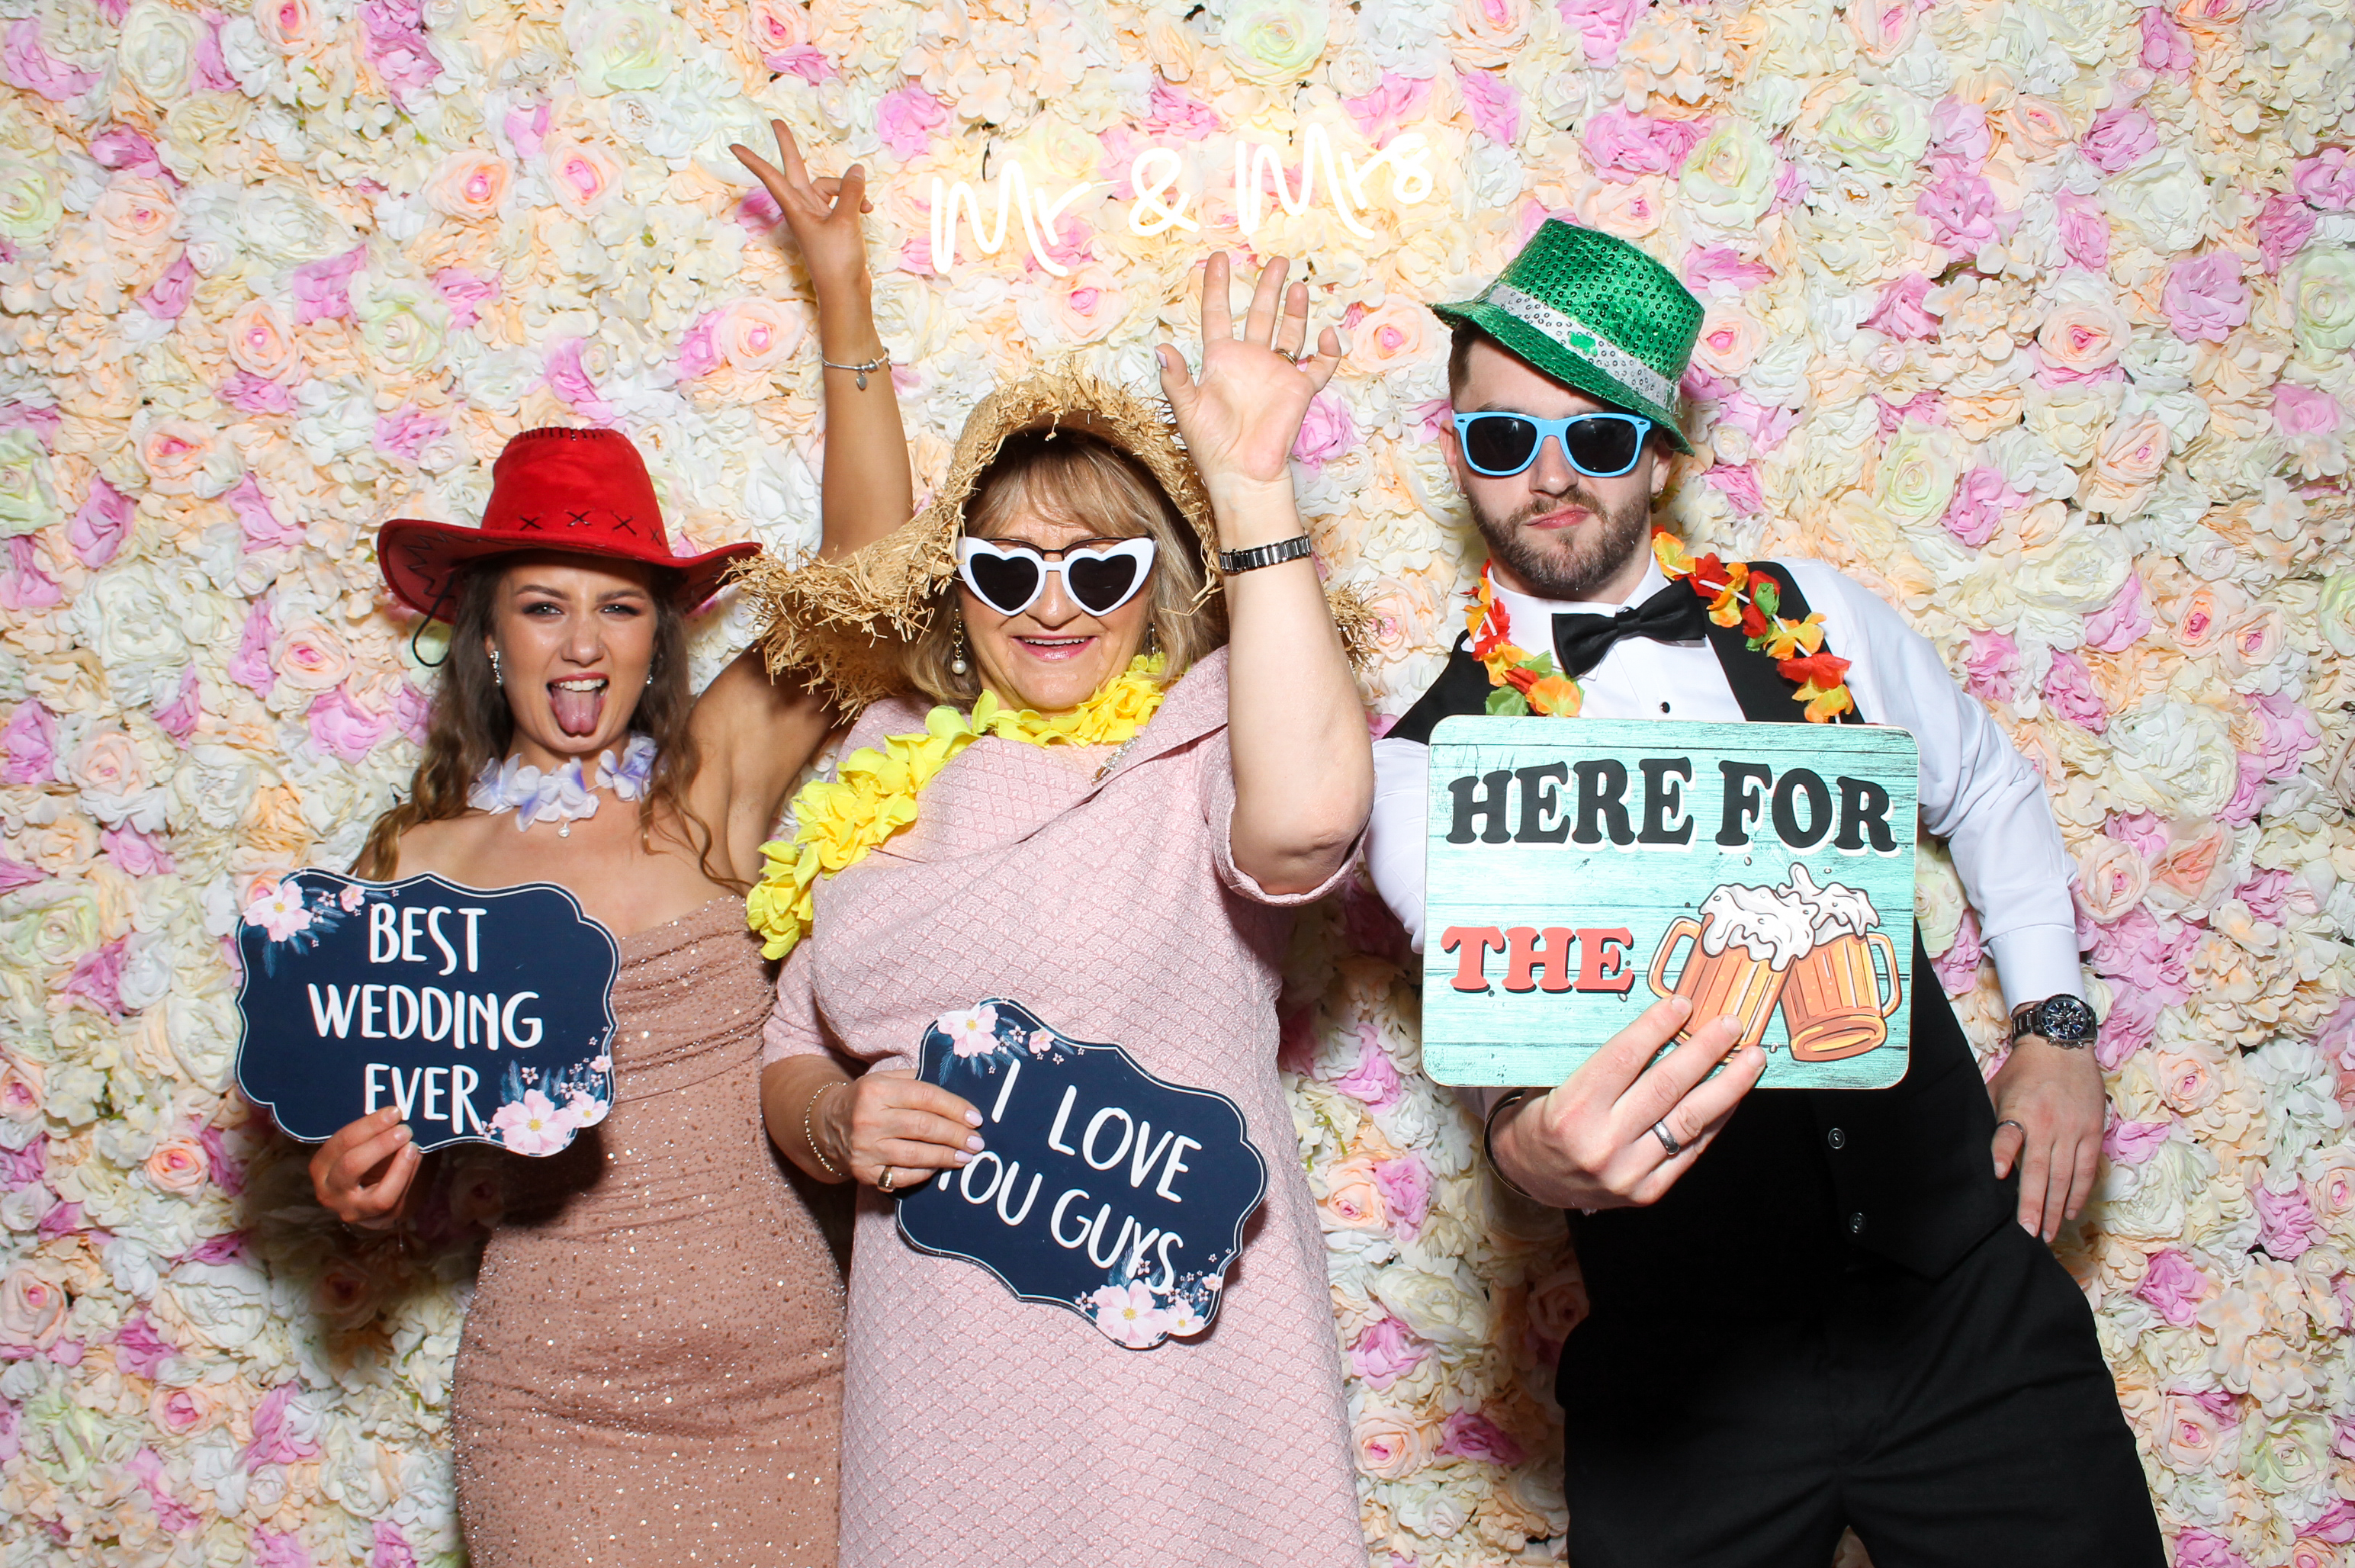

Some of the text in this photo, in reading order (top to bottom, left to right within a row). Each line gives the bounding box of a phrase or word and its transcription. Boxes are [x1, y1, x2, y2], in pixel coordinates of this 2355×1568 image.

[930, 122, 1433, 277] Mr & Mrs
[1446, 757, 1899, 855] HERE FOR
[369, 902, 487, 976] BEST
[1440, 925, 1635, 994] THE
[307, 982, 544, 1051] WEDDING
[365, 1063, 484, 1135] EVER
[991, 1058, 1203, 1203] I LOVE
[1050, 1188, 1184, 1295] GUYS
